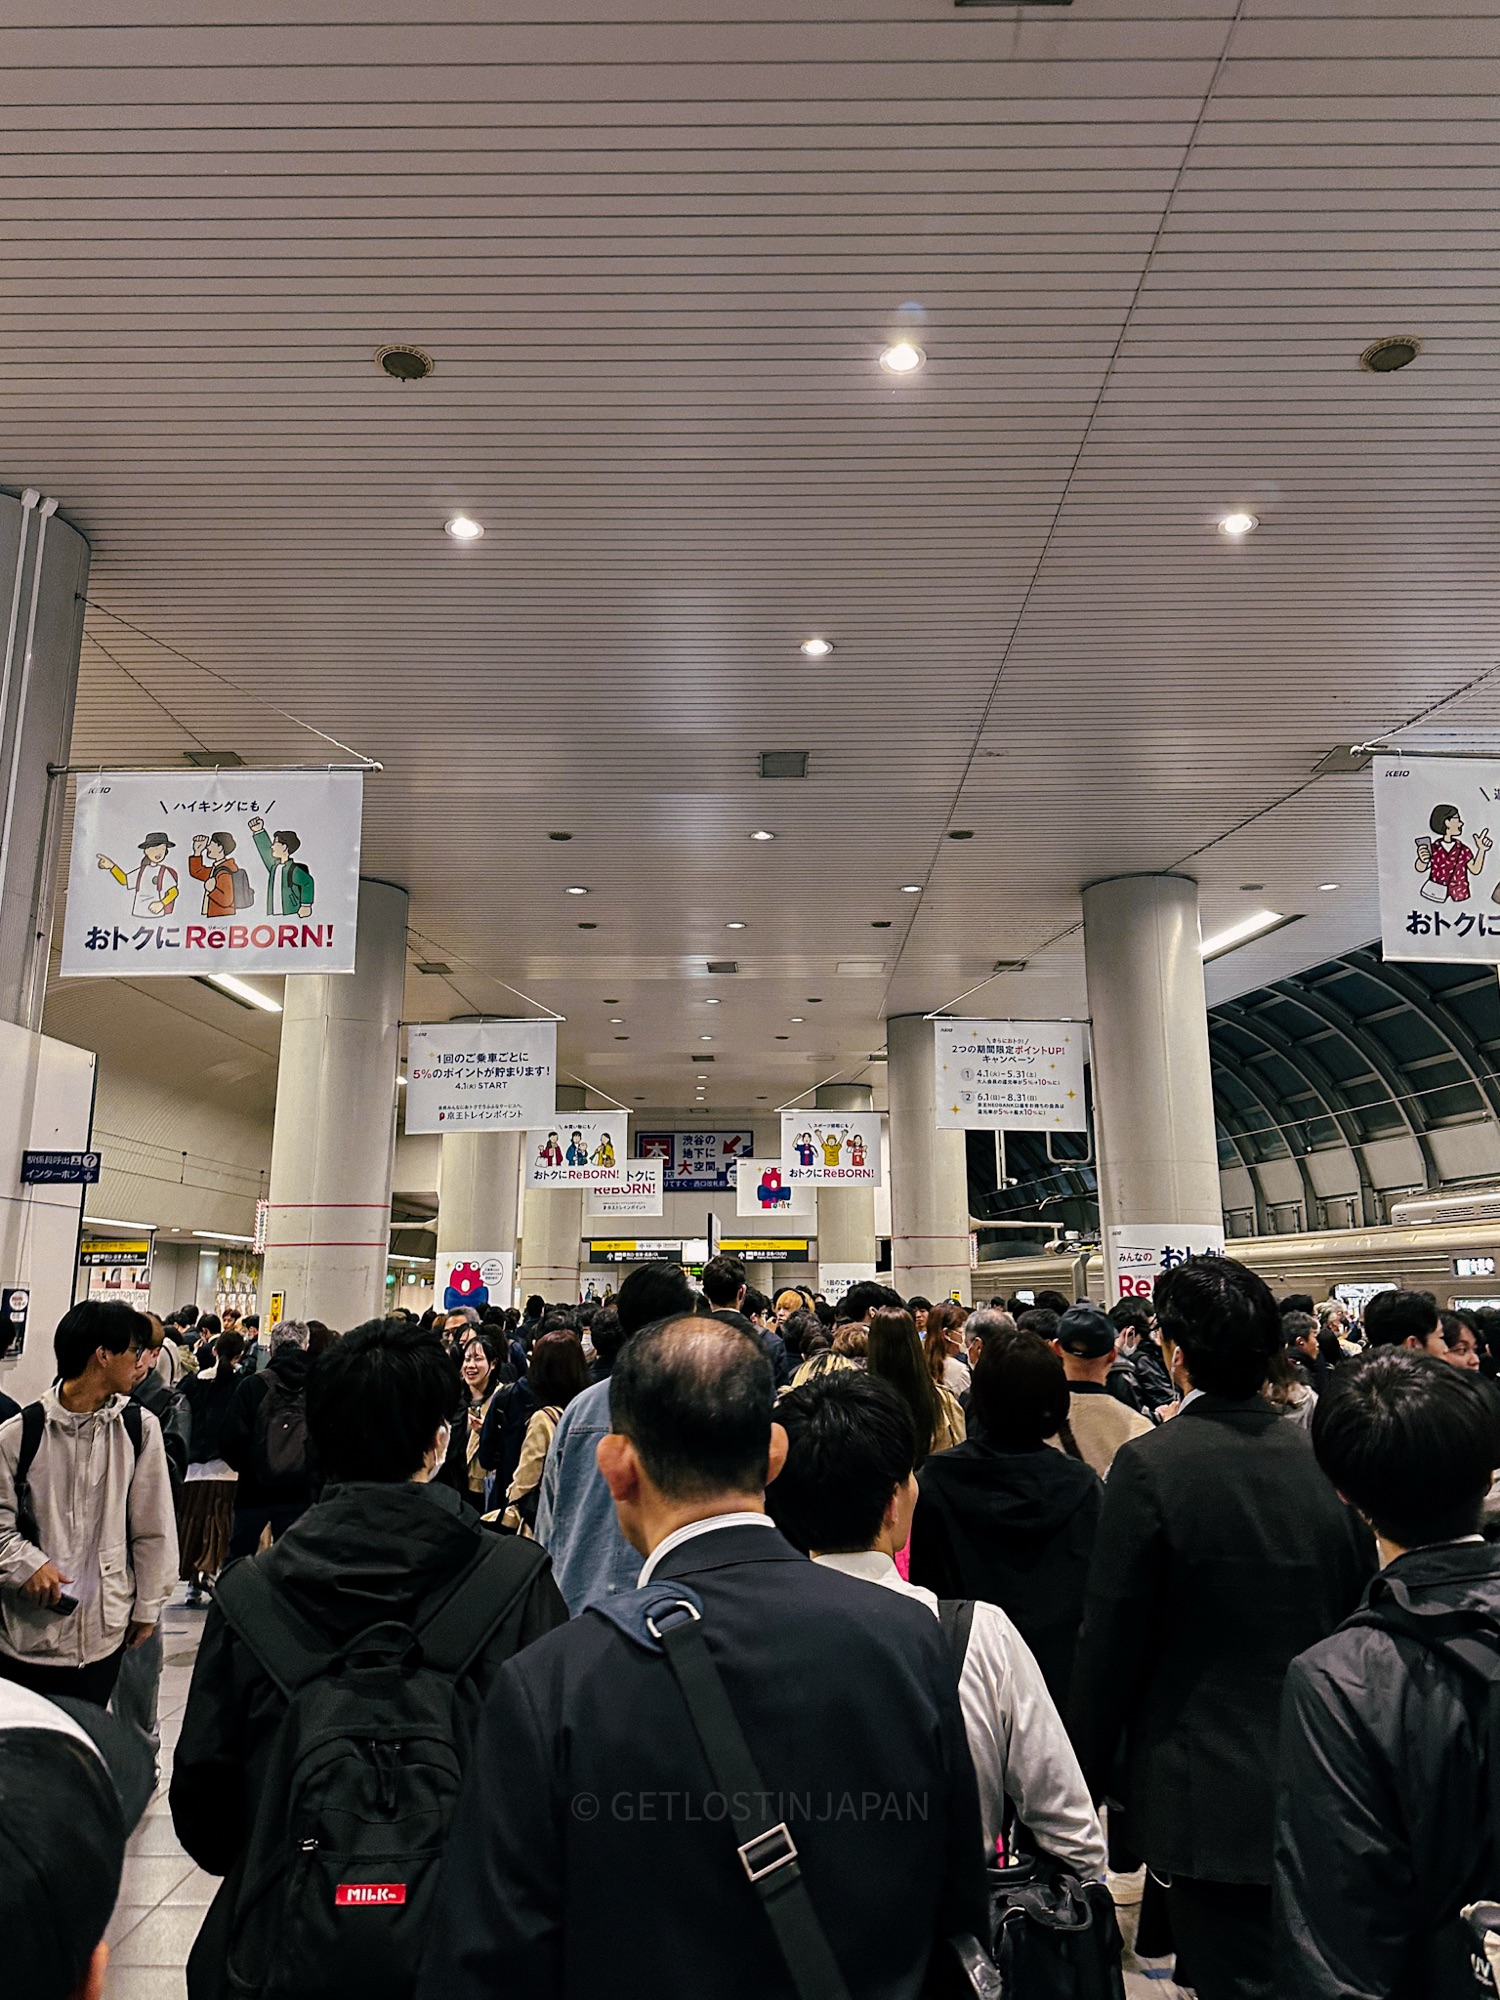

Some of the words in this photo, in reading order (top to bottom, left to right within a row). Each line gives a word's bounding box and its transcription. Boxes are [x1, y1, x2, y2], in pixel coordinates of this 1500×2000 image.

[173, 801, 260, 813] ハイキングにも
[1406, 910, 1500, 938] おトクに
[952, 1045, 1065, 1055] 2つの期間限定ポイントUP!
[437, 1052, 529, 1064] 1回のご乗車ごとに
[982, 1055, 1035, 1064] キャンペーン
[413, 1066, 550, 1079] 5%のポイントが貯まります!
[478, 1082, 508, 1090] START
[446, 1110, 523, 1120] 京王トレインポイント
[682, 1135, 716, 1146] 渋谷の
[682, 1148, 716, 1159] 地下に
[26, 1169, 80, 1179] インターホン
[1119, 1252, 1153, 1262] みんなの
